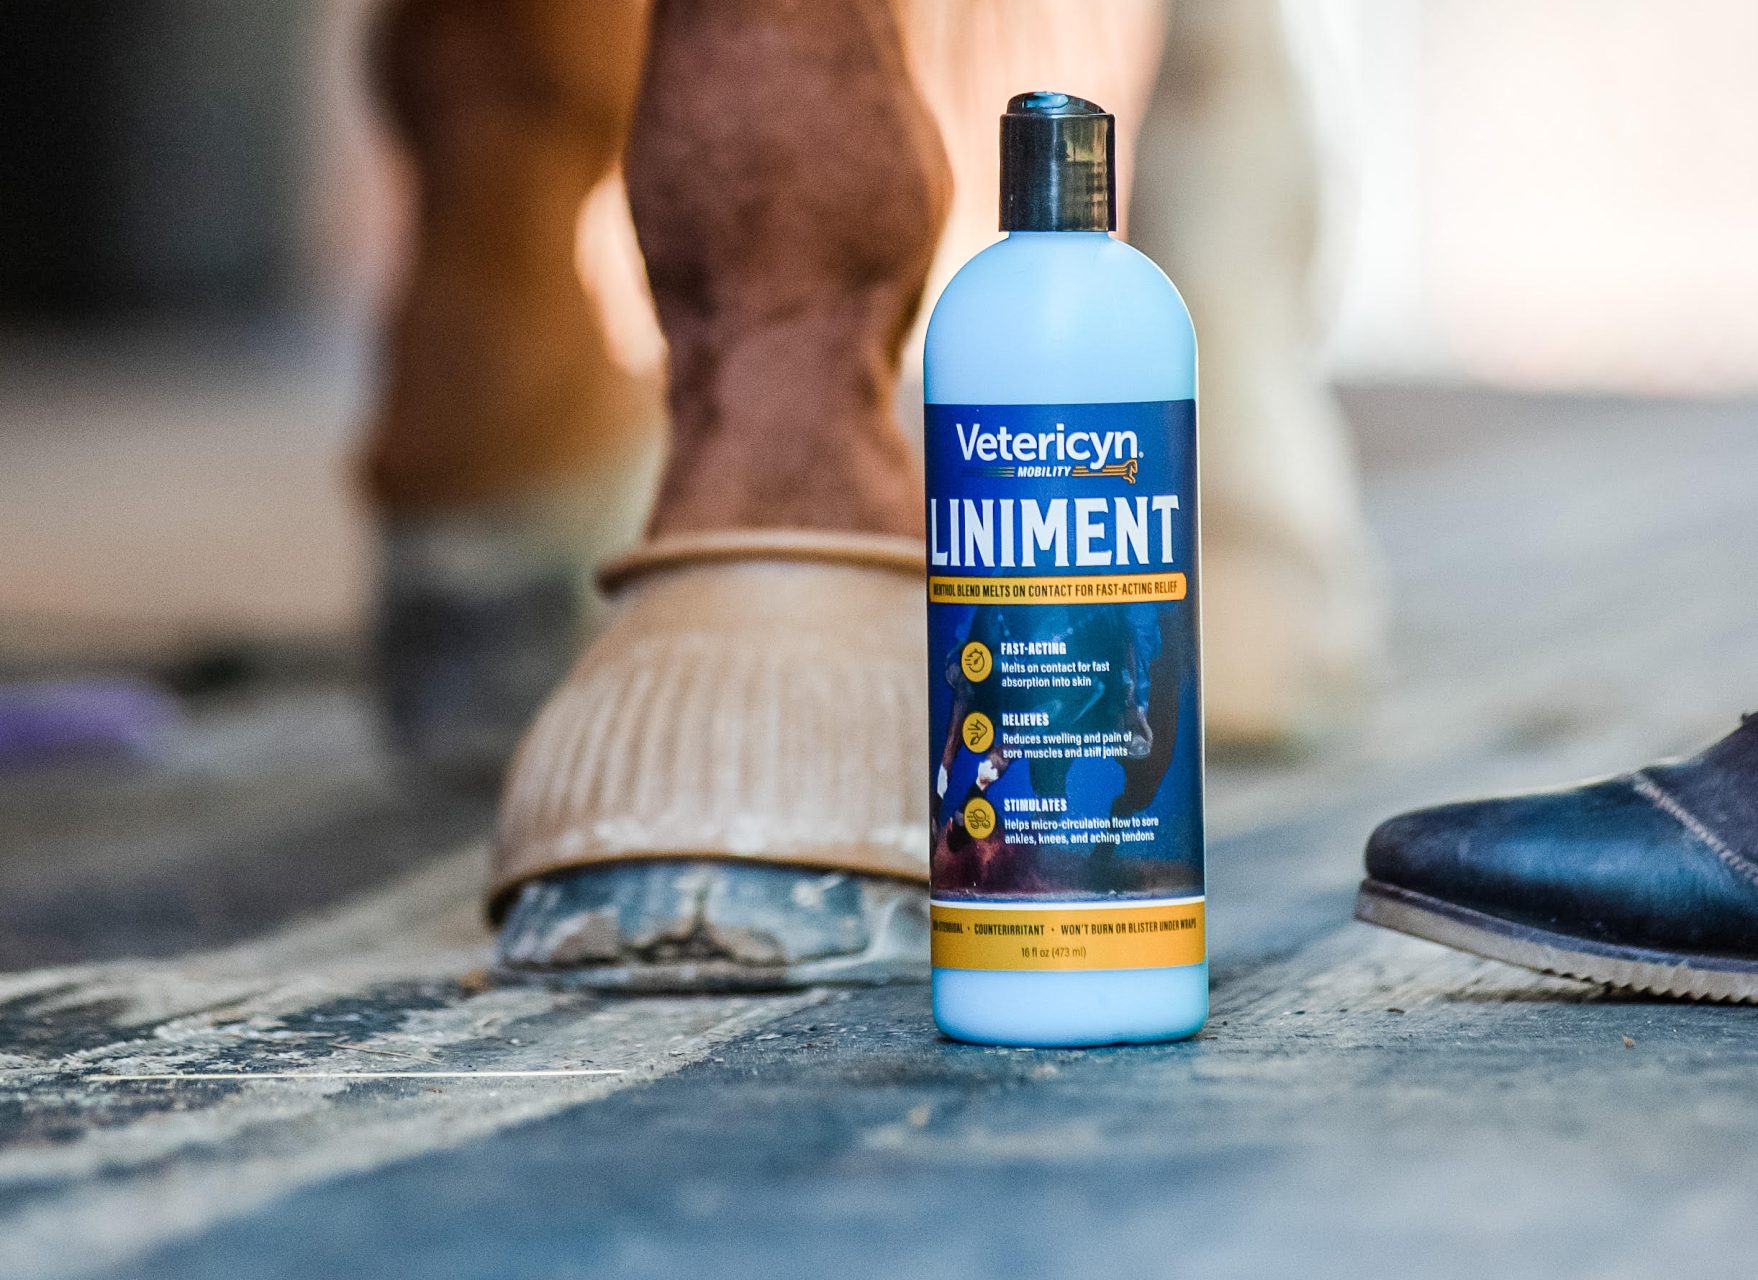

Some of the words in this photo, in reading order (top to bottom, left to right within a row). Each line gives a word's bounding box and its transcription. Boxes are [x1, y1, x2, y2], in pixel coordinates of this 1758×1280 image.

[956, 423, 1138, 469] Vetericyn
[1017, 466, 1072, 478] MOBILITY
[930, 495, 1180, 567] LINIMENT
[957, 584, 980, 597] BLEND
[982, 585, 1011, 598] MELTS
[1012, 585, 1026, 598] ON
[1028, 584, 1072, 598] CONTACT
[1075, 584, 1094, 597] FOR
[1096, 582, 1153, 596] FAST-ACTING
[1154, 580, 1178, 594] RELIEF
[1000, 642, 1067, 656] FAST-ACTING
[1001, 662, 1026, 673] Melts
[1027, 663, 1039, 673] on
[1040, 662, 1076, 673] contact
[1077, 661, 1091, 672] for
[1092, 660, 1110, 672] fast
[1001, 677, 1050, 689] absorption
[1052, 676, 1071, 687] into
[1072, 676, 1092, 687] skin
[1002, 713, 1050, 727] RELIEVES
[1003, 733, 1041, 745] Reduces
[1042, 732, 1082, 746] swelling
[1083, 732, 1101, 744] and
[1102, 732, 1122, 745] pain
[1123, 731, 1133, 742] of
[1002, 748, 1023, 759] sore
[1024, 747, 1063, 759] muscles
[1064, 746, 1083, 758] and
[1084, 746, 1102, 758] stiff
[1102, 746, 1128, 759] joints
[1004, 798, 1068, 812] STIMULATES
[1004, 819, 1030, 832] Helps
[1031, 817, 1111, 830] micro-circulation
[1112, 817, 1131, 829] flow
[1132, 817, 1141, 828] to
[1141, 816, 1160, 827] sore
[1005, 833, 1037, 845] ankles,
[1038, 833, 1069, 845] knees,
[1070, 832, 1089, 844] and
[1090, 831, 1121, 845] aching
[1121, 830, 1155, 843] tendons
[974, 923, 1045, 936] COUNTERIRRITANT
[1060, 924, 1089, 936] WON'T
[1091, 923, 1114, 935] BURN
[1115, 923, 1127, 934] OR
[1128, 921, 1158, 934] BLISTER
[1159, 920, 1180, 932] UNDER
[1021, 947, 1030, 958] 16
[1039, 949, 1050, 958] oz
[1051, 946, 1070, 959] (473
[1072, 946, 1087, 958] ml)
